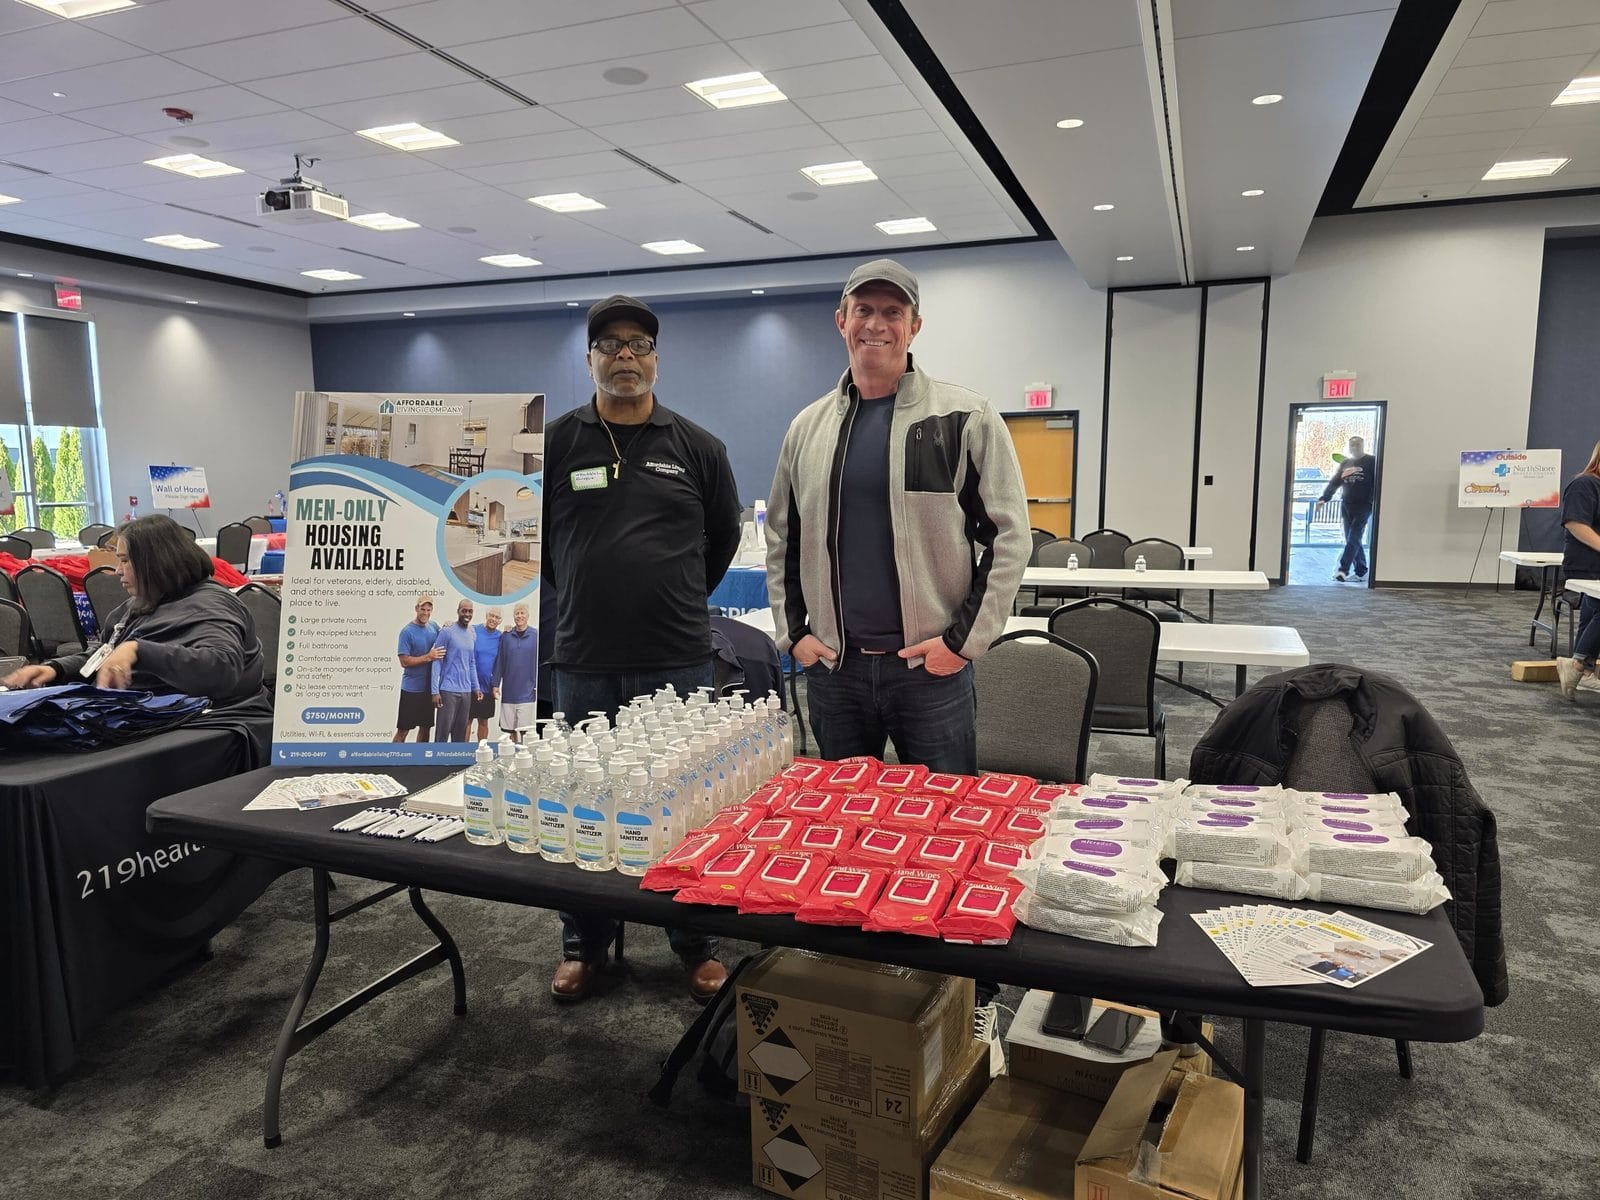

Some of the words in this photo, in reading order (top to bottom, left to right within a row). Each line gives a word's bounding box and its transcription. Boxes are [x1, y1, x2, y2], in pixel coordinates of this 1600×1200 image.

[1329, 382, 1349, 396] EXIT
[1512, 464, 1556, 472] NorthShore
[296, 498, 388, 522] MEN-ONLY
[305, 524, 381, 546] HOUSING
[310, 548, 404, 570] AVAILABLE
[291, 576, 312, 585] Ideal
[314, 577, 324, 585] for
[327, 578, 364, 586] veterans,
[366, 577, 394, 587] elderly,
[396, 578, 431, 586] disabled,
[290, 588, 306, 596] and
[336, 589, 366, 598] seeking
[376, 589, 395, 598] safe,
[397, 589, 445, 597] comfortable
[289, 599, 313, 608] place
[305, 711, 361, 720] $750/MONTH
[540, 820, 565, 829] SANITIZER
[916, 870, 941, 879] Wipes
[885, 1098, 902, 1114] 24
